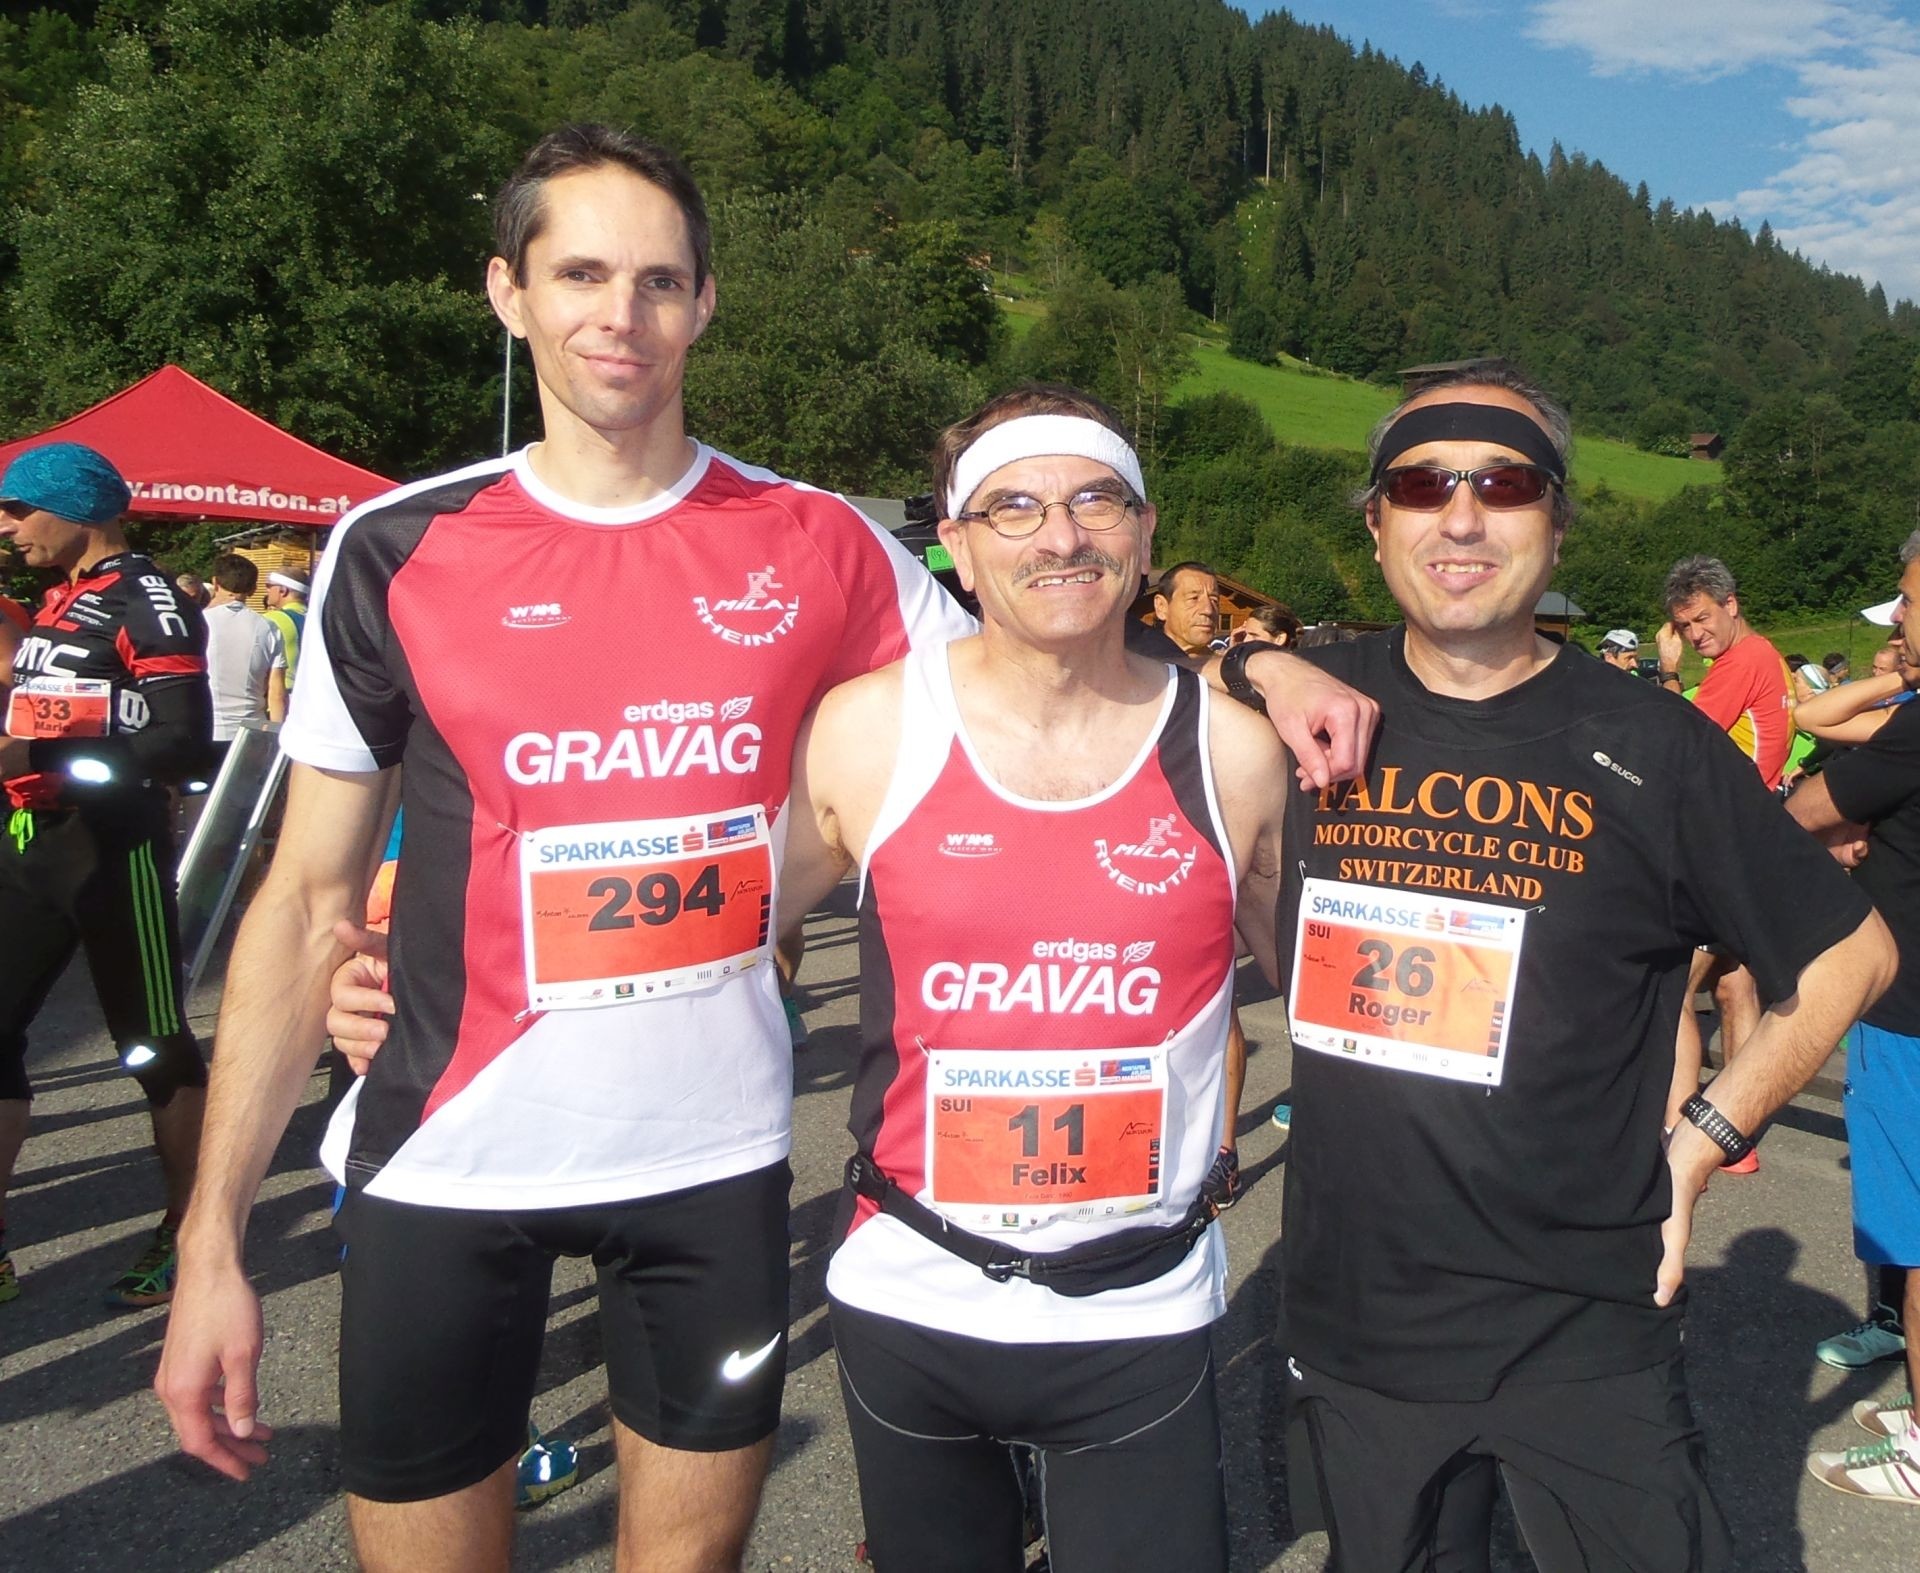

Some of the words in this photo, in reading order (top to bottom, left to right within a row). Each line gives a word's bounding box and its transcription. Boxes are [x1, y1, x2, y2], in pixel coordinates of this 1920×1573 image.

[138, 574, 189, 637] BMC
[693, 595, 800, 646] RHEINTAL
[36, 697, 71, 721] 33
[624, 700, 714, 724] erdgas
[34, 721, 72, 733] Mario
[504, 723, 763, 786] GRAVAG
[539, 834, 679, 864] SPARKASSE
[1313, 824, 1500, 859] MOTORCYCLE
[1507, 840, 1585, 873] CLUB
[1094, 839, 1197, 896] RHEINTAL
[1339, 858, 1542, 901] SWITZERLAND
[587, 864, 725, 932] 294
[1312, 896, 1420, 929] SPARKASSE
[1308, 923, 1331, 940] SUI
[1032, 938, 1117, 963] erdgas
[1351, 938, 1437, 998] 26
[921, 962, 1162, 1015] GRAVAG
[1348, 992, 1432, 1027] Roger
[944, 1069, 1071, 1088] SPARKASSE
[940, 1099, 972, 1113] SUI
[1008, 1104, 1085, 1158] 11
[1012, 1164, 1087, 1187] Felix
